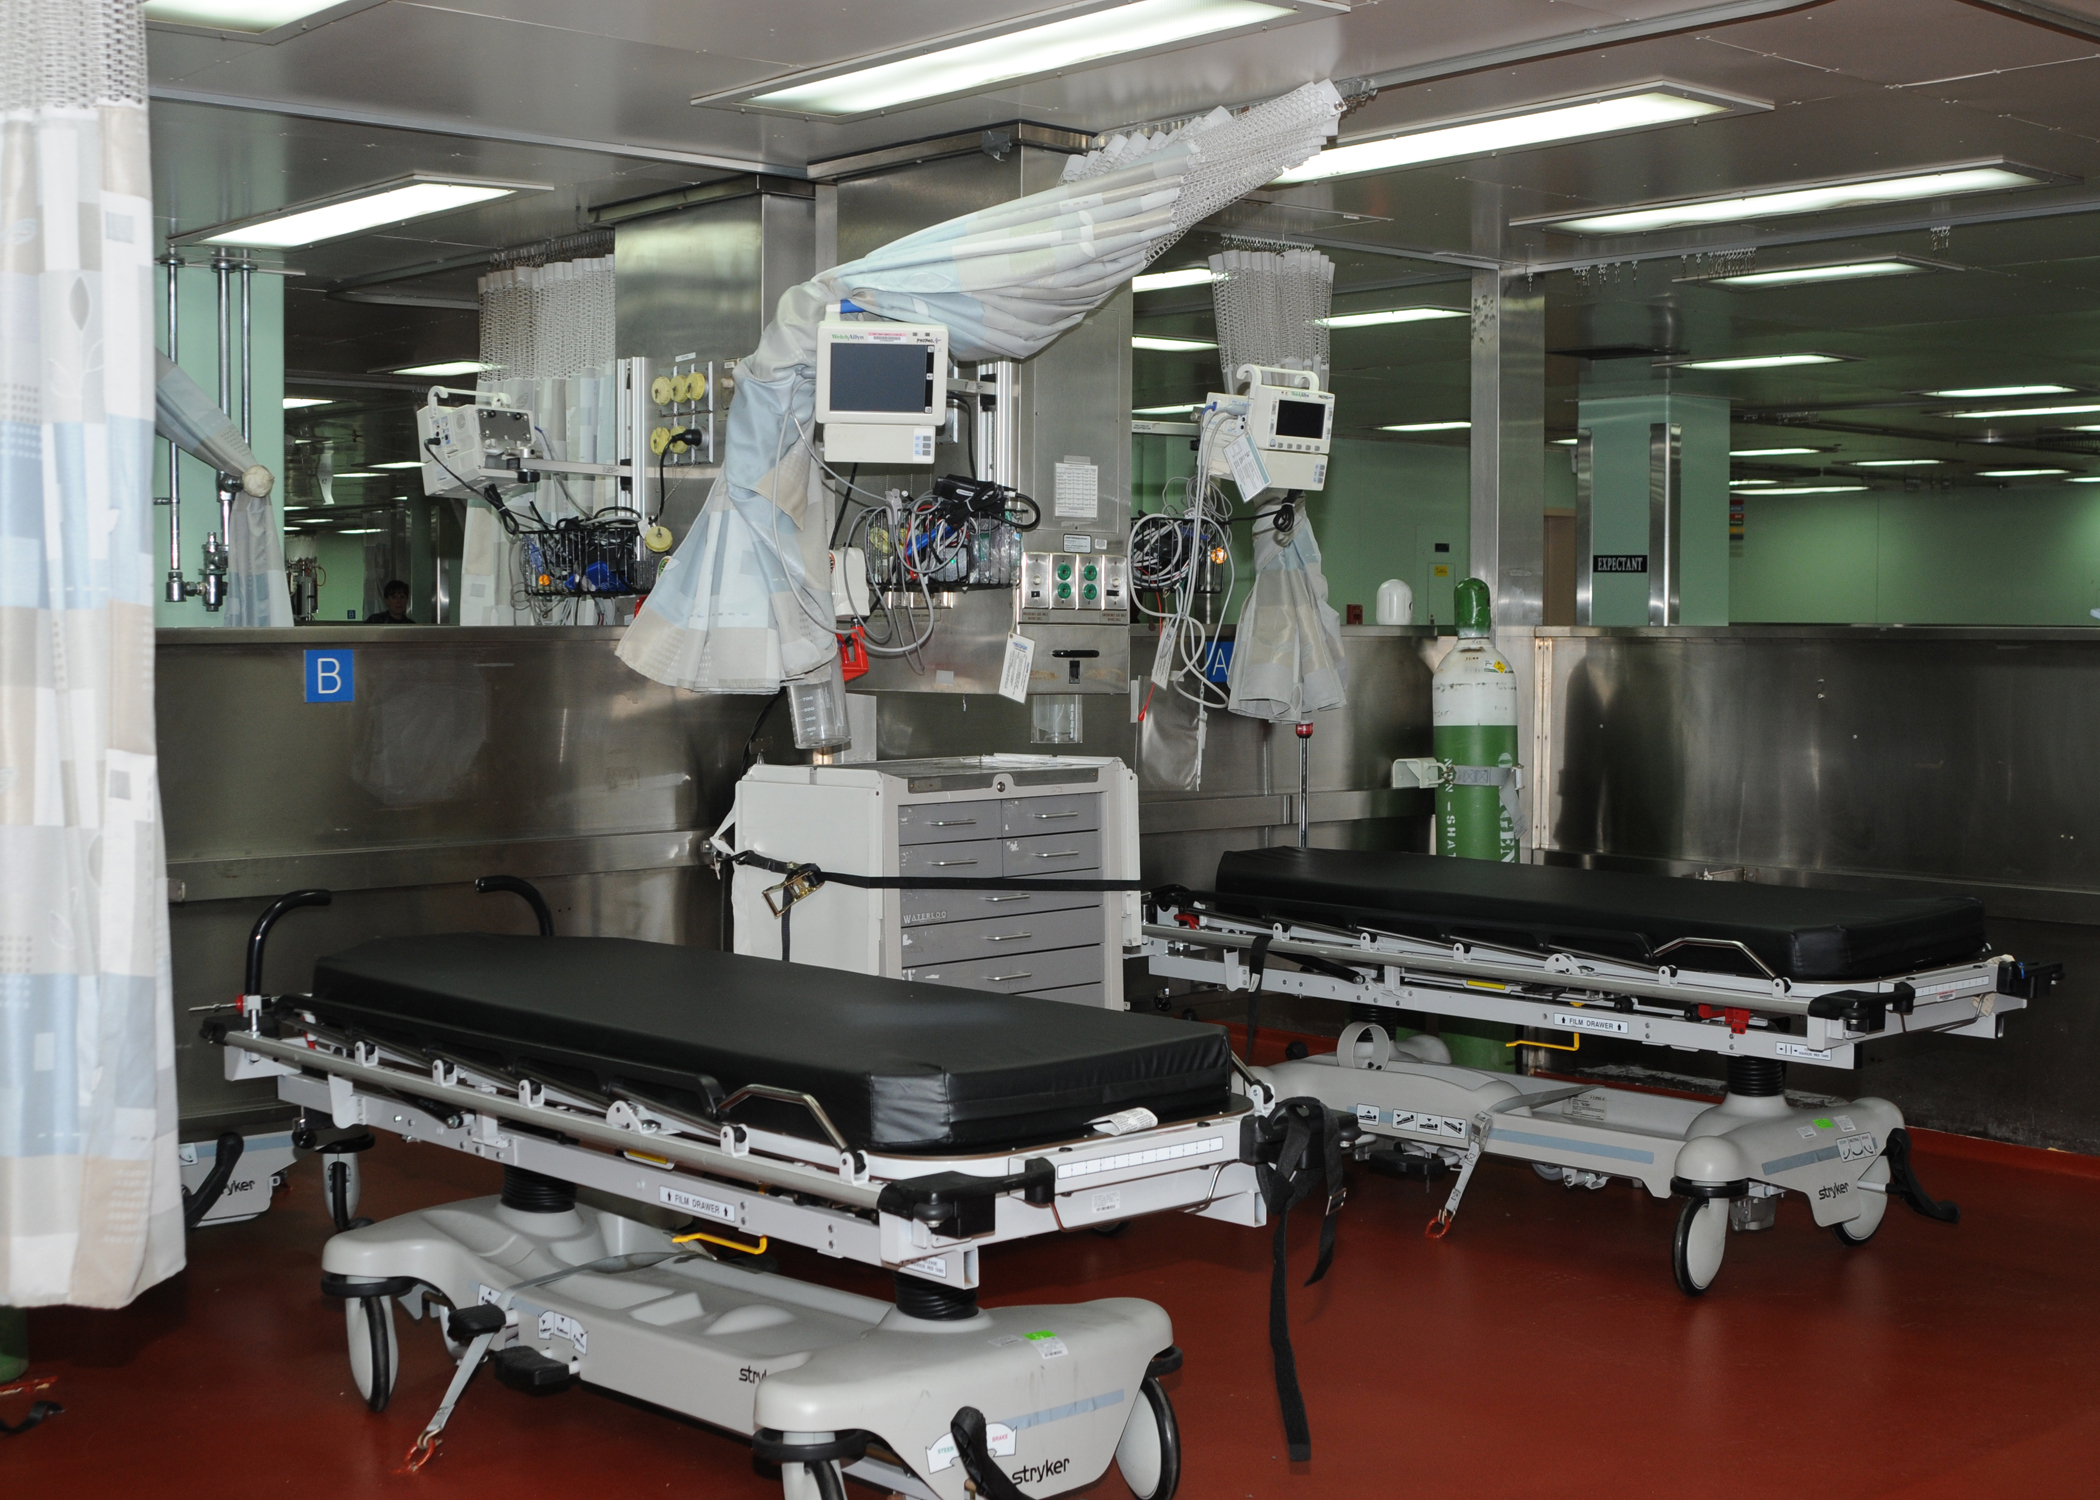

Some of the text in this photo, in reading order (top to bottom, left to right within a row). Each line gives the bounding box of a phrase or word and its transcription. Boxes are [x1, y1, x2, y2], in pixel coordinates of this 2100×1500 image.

[1597, 557, 1643, 571] EXPECTANT
[1212, 648, 1228, 676] A
[317, 657, 341, 694] B
[1498, 752, 1515, 863] OGEN
[903, 911, 947, 924] WATERLOO
[1569, 1017, 1614, 1030] FILM DRAWER
[223, 1180, 256, 1196] yker
[1818, 1181, 1850, 1200] stryker
[674, 1194, 720, 1215] FILM DRAWER
[992, 1433, 1008, 1443] BRAKE
[937, 1445, 954, 1455] STEER
[1011, 1457, 1070, 1486] stryker
